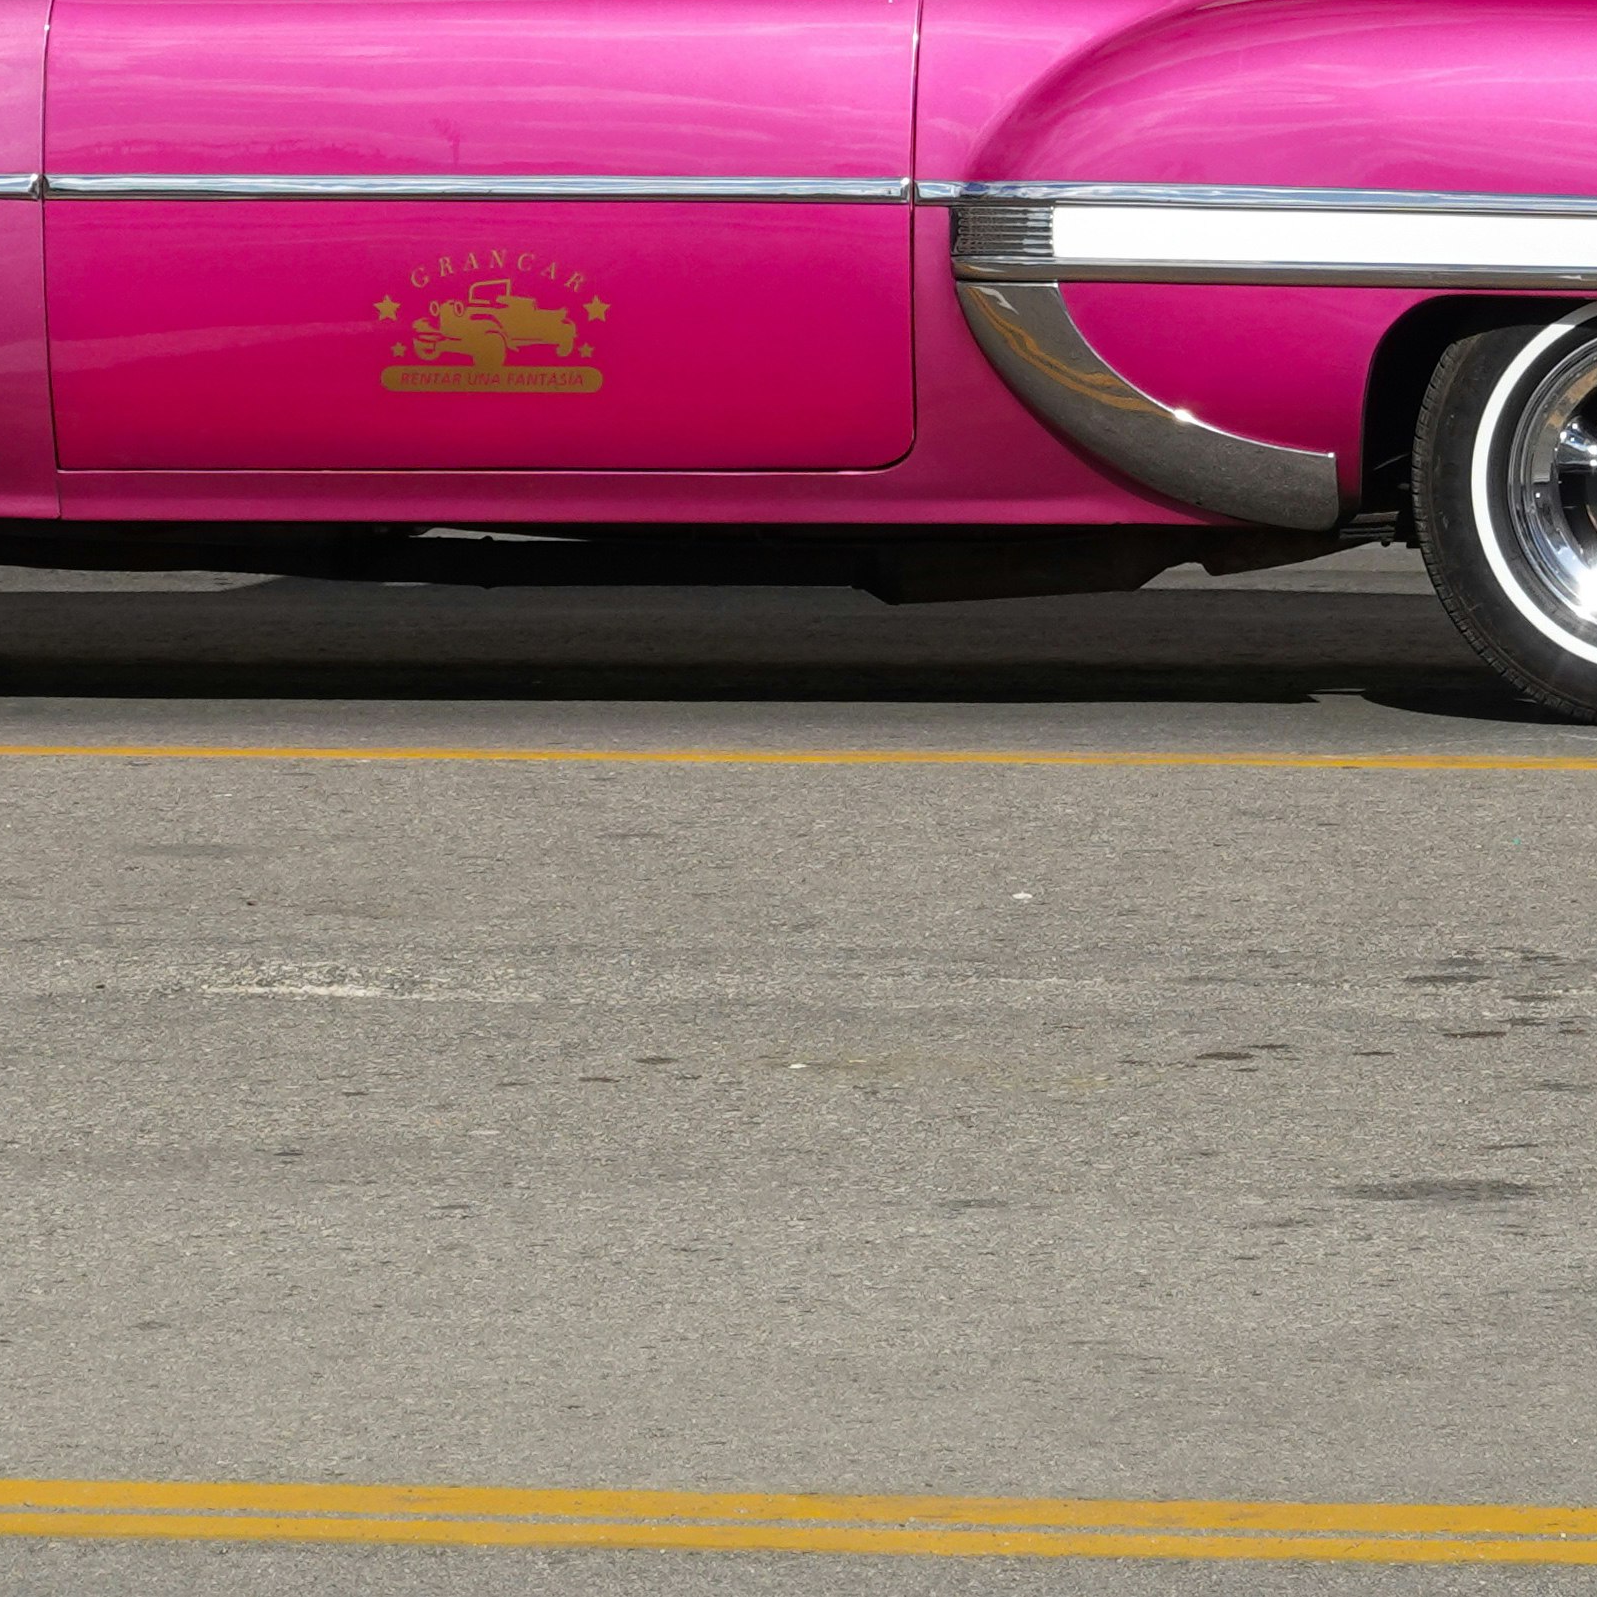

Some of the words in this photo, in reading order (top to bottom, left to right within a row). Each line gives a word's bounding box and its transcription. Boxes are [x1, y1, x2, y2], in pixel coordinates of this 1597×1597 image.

[410, 249, 586, 292] GRANCAR
[399, 371, 461, 386] RENTAR
[467, 371, 501, 386] UNA
